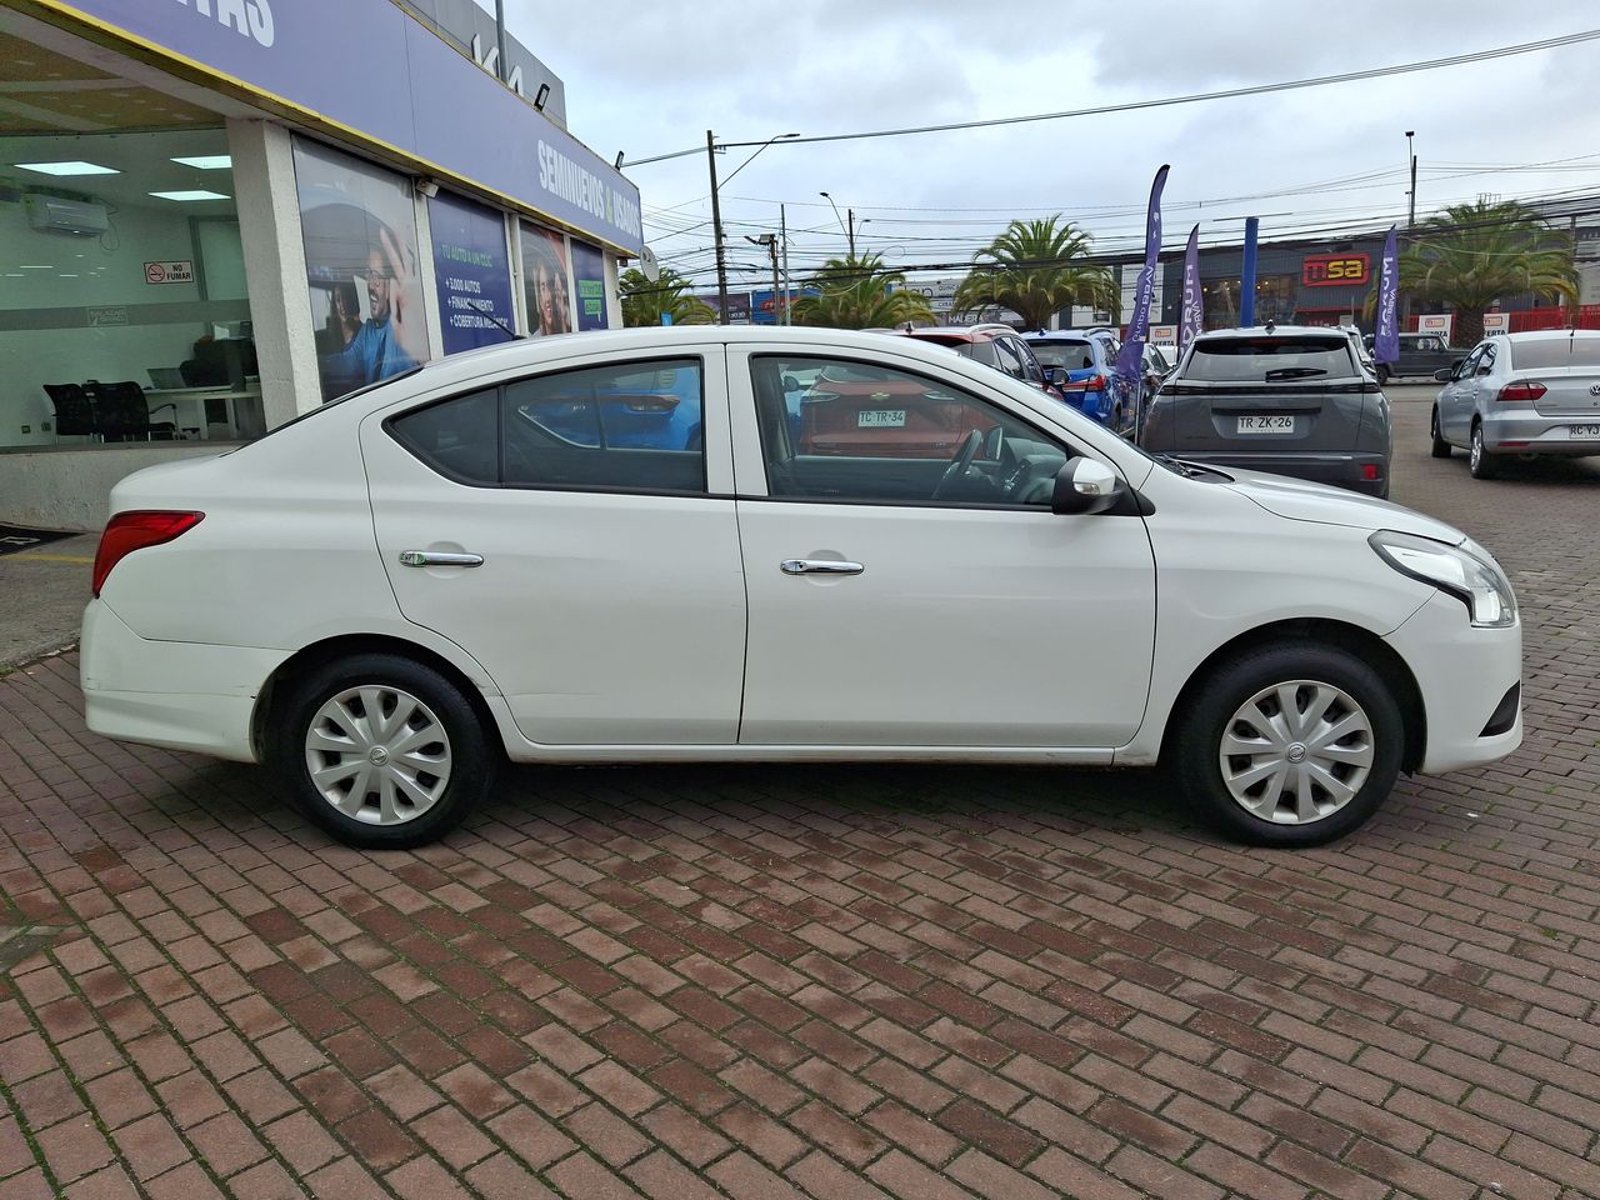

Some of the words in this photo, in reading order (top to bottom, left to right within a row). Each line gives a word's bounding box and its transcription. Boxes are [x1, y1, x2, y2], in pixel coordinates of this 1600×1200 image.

[538, 140, 605, 220] SEMINUEVOS
[166, 272, 191, 280] FUMAR
[1306, 260, 1363, 280] msa
[1240, 417, 1253, 427] TR
